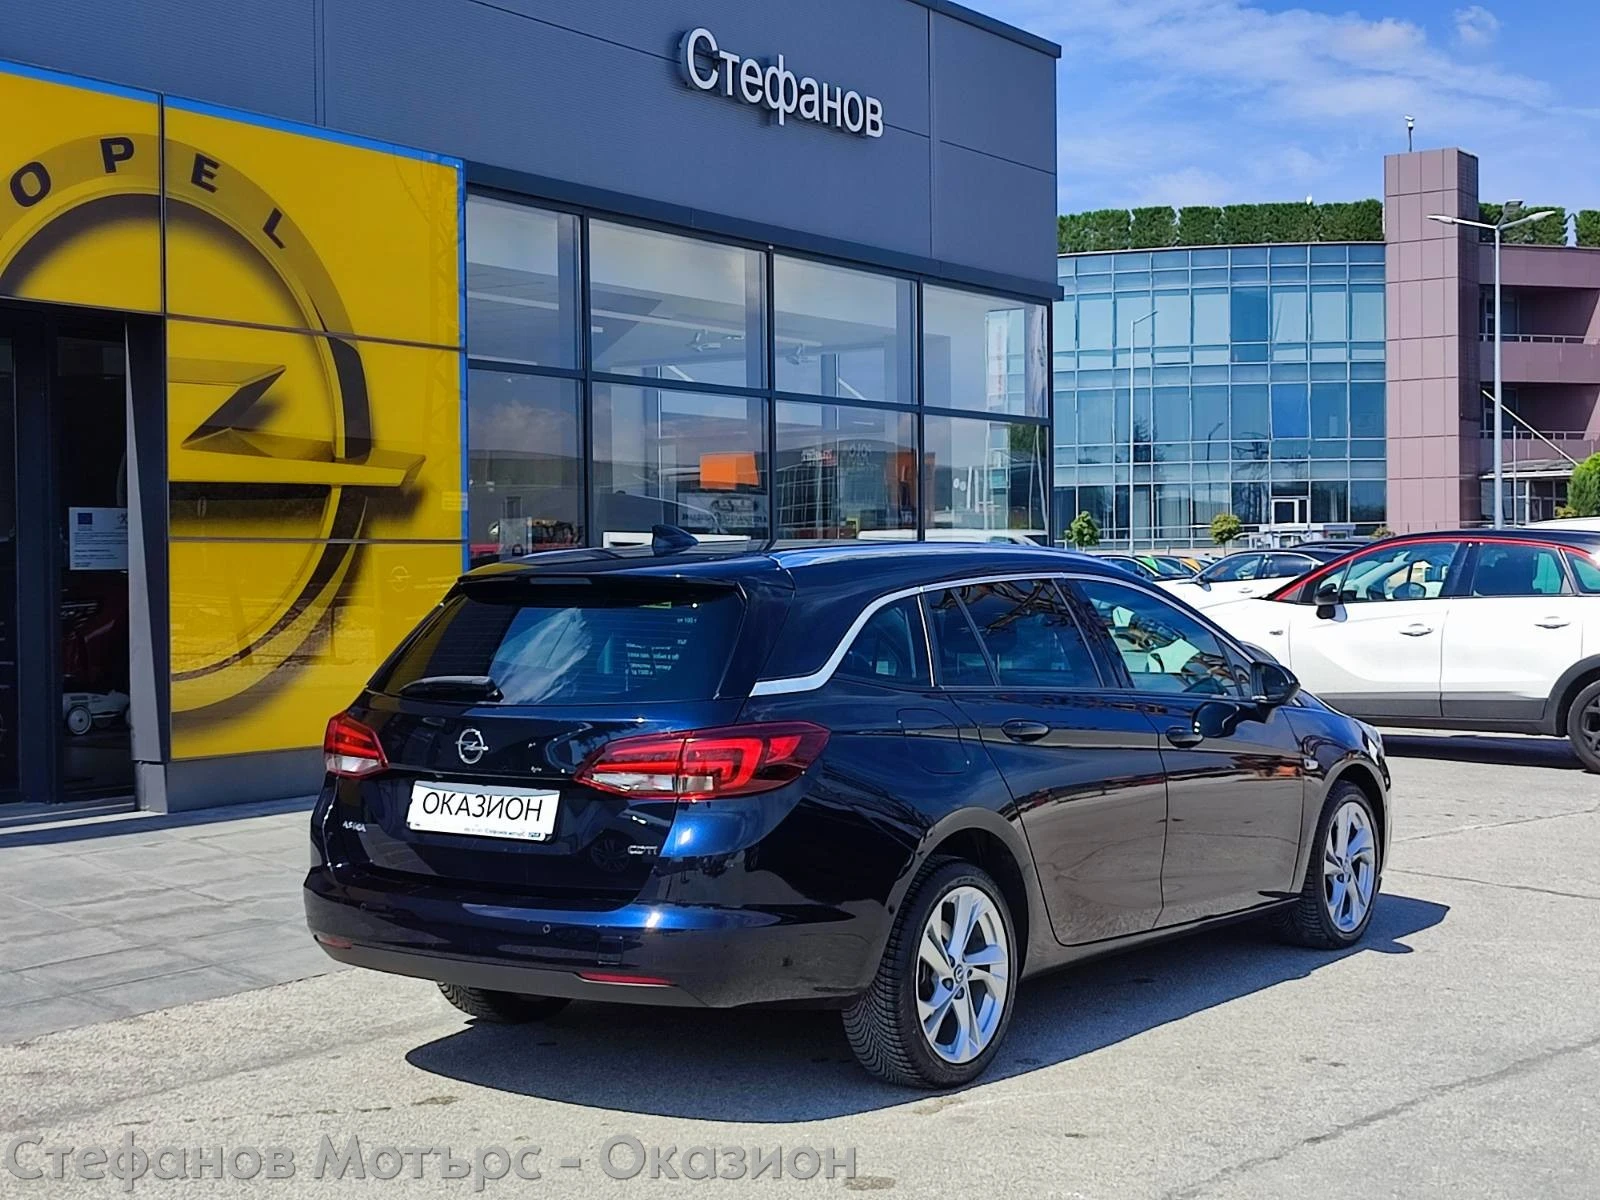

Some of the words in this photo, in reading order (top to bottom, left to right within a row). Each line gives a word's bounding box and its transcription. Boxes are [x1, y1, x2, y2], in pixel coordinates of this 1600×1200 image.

[684, 28, 884, 138] Стефанов
[10, 137, 287, 249] OPEL
[422, 791, 543, 822] ОКАЗИОН
